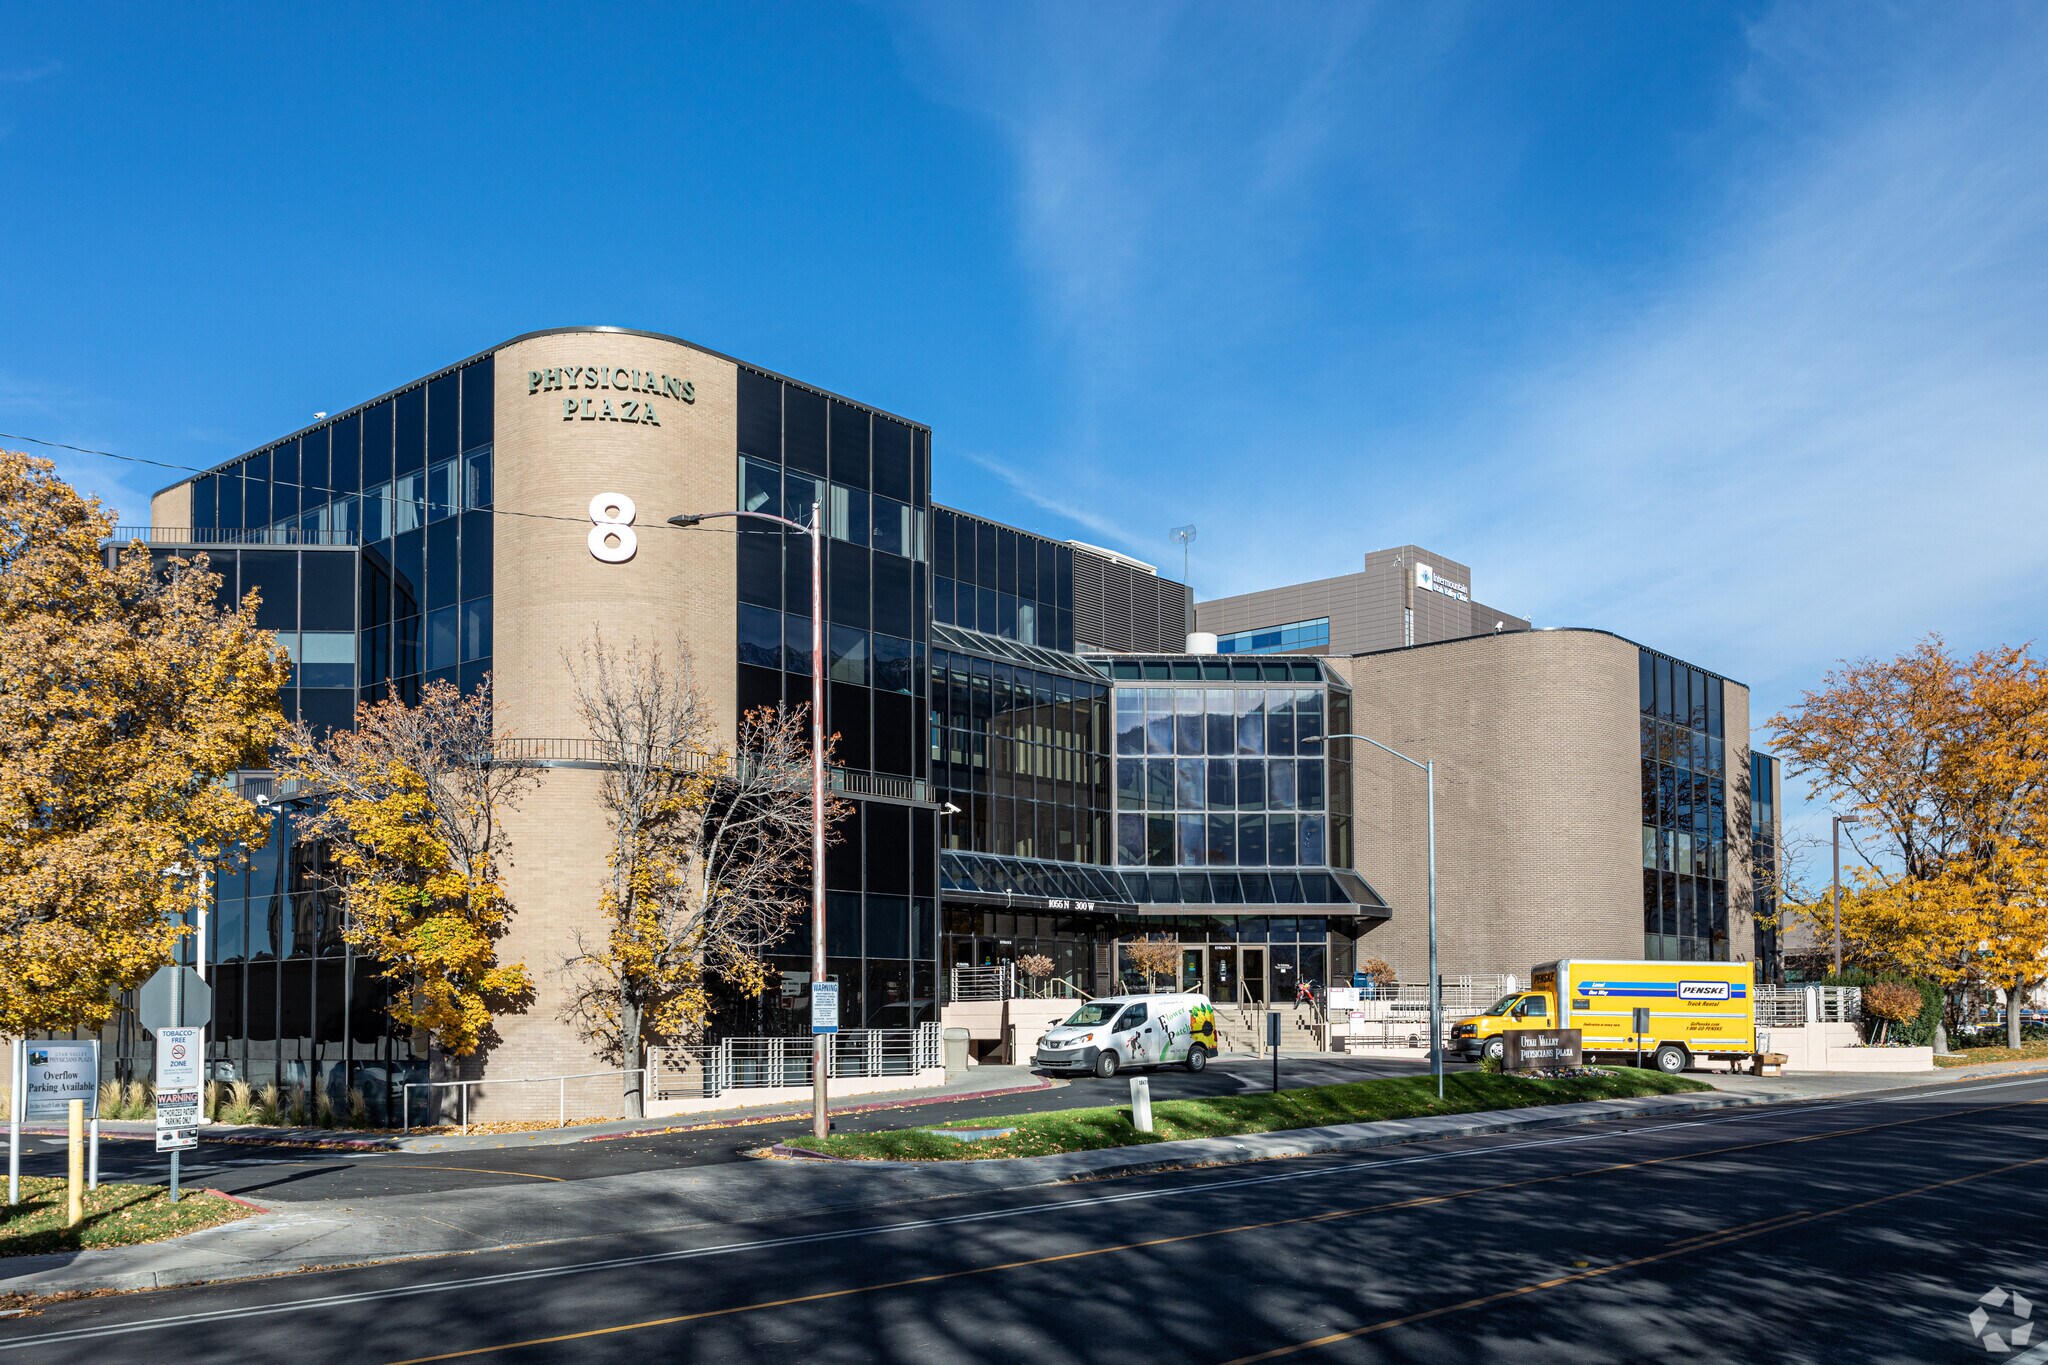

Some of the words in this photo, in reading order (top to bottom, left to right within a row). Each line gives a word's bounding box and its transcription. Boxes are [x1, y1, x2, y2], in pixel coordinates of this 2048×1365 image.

[528, 366, 695, 404] PHYSICIANS
[563, 397, 661, 427] PLAZA
[587, 492, 638, 564] 8
[1433, 572, 1468, 594] Intermountain
[1048, 899, 1063, 909] 1055
[1064, 900, 1070, 909] N
[1075, 901, 1087, 910] 300
[1088, 902, 1095, 911] W
[813, 984, 837, 992] WARNING
[1158, 1007, 1185, 1031] Flower
[1168, 1023, 1190, 1046] Patch
[1520, 1049, 1553, 1061] PHYSICIANS
[1555, 1048, 1574, 1059] PLAZA
[43, 1070, 79, 1080] Overflow
[28, 1082, 59, 1094] Parking
[60, 1081, 95, 1091] Available
[157, 1093, 198, 1104] WARNING
[159, 1109, 183, 1117] AUTHORIZED
[183, 1107, 198, 1116] PATIENT
[165, 1117, 182, 1125] PARKING
[182, 1116, 192, 1124] ONLY
